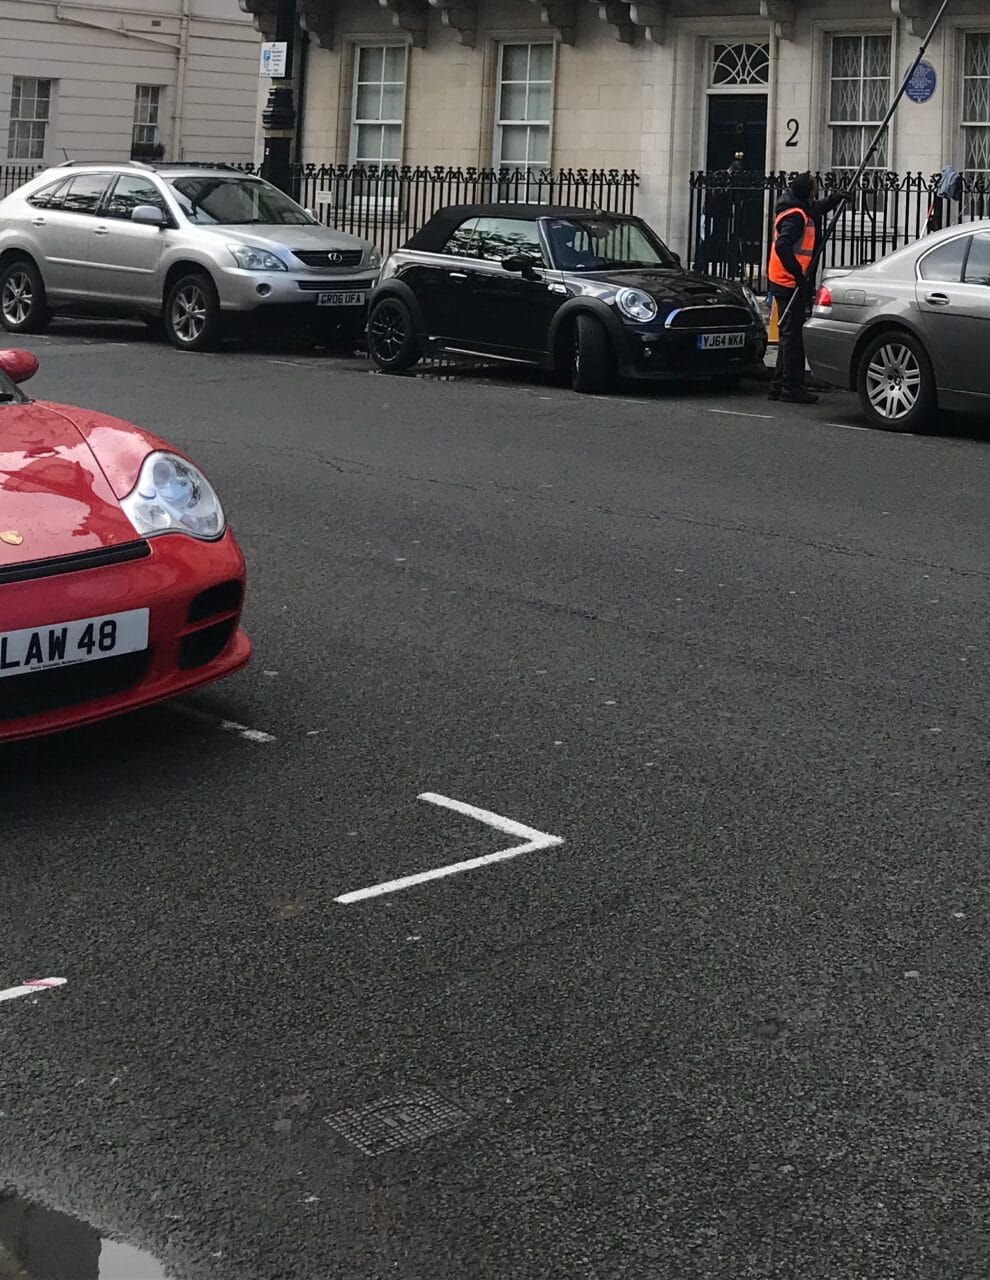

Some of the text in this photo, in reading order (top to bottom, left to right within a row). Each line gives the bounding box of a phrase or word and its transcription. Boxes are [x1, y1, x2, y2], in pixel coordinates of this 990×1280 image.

[785, 118, 800, 147] 2
[320, 294, 344, 304] GR06
[703, 335, 726, 347] YJ64
[0, 619, 117, 669] LAW 48
